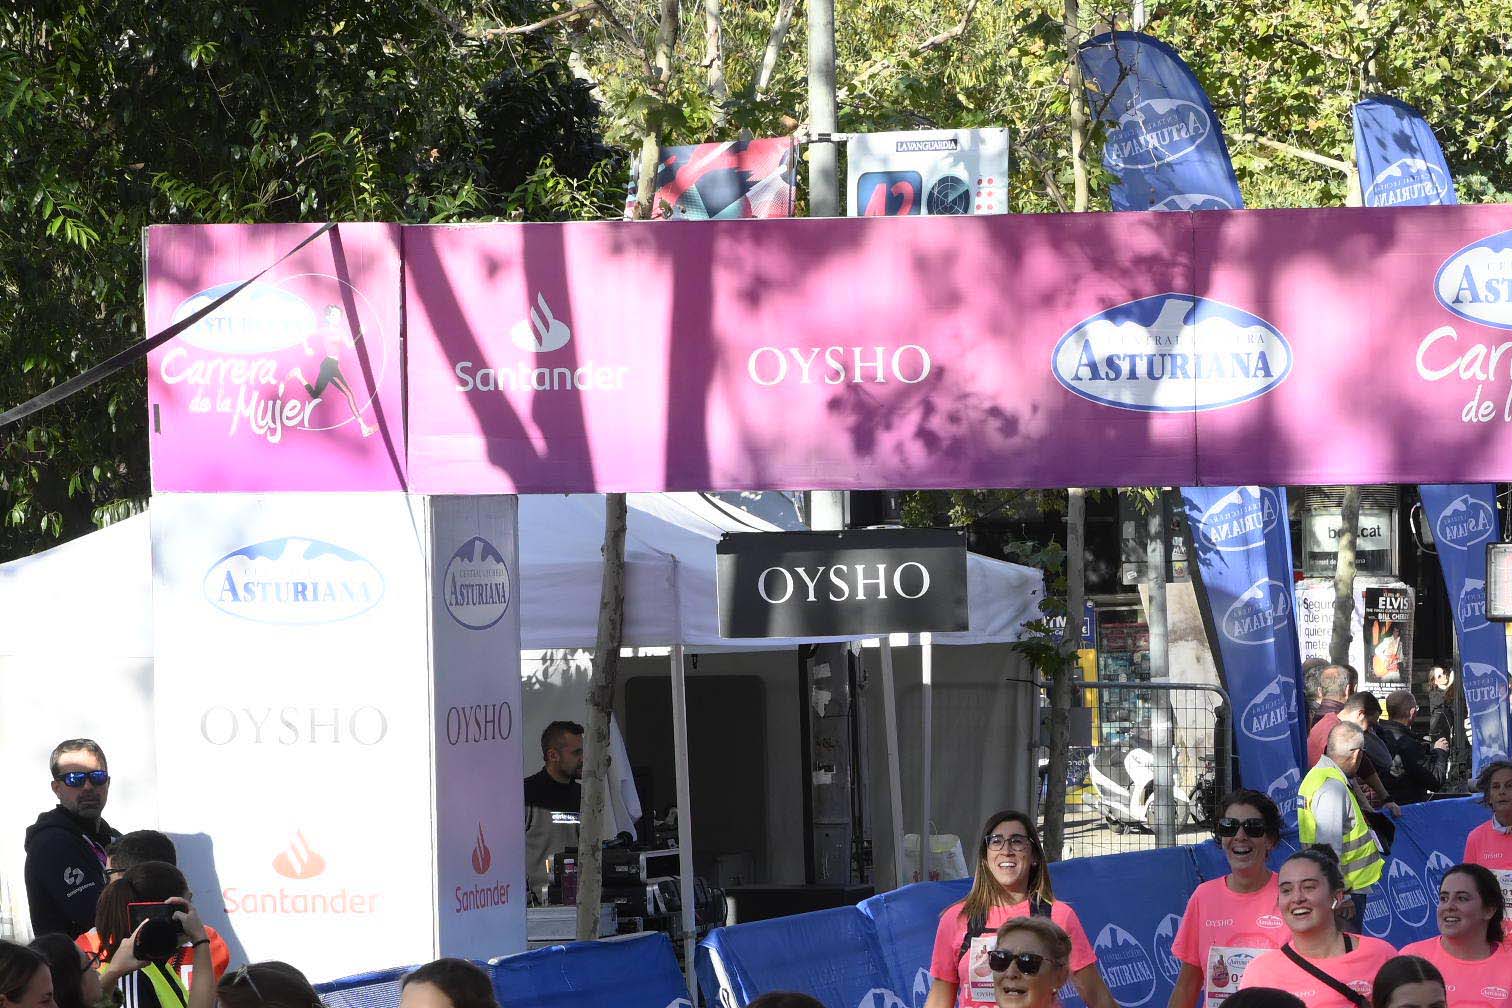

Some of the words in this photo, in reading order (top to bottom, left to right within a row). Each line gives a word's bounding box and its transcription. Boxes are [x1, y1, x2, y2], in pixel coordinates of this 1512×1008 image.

[160, 347, 277, 385] Carrera
[455, 360, 630, 393] Santander
[747, 344, 931, 386] OYSHO
[1071, 338, 1274, 382] ASTURIANA
[229, 383, 322, 443] Mujer
[1462, 384, 1496, 423] de
[218, 569, 373, 603] ASTURIANA
[449, 574, 507, 608] ASTURIANA
[757, 561, 931, 605] OYSHO
[1303, 597, 1335, 610] Segur
[1304, 614, 1320, 624] que
[1378, 597, 1409, 609] ELVIS
[200, 703, 388, 746] OYSHO
[446, 700, 512, 746] OYSHO
[222, 886, 380, 914] Santander
[454, 884, 510, 914] Santander
[1205, 918, 1234, 928] OYSHO
[1100, 957, 1154, 989] ASTURIANA
